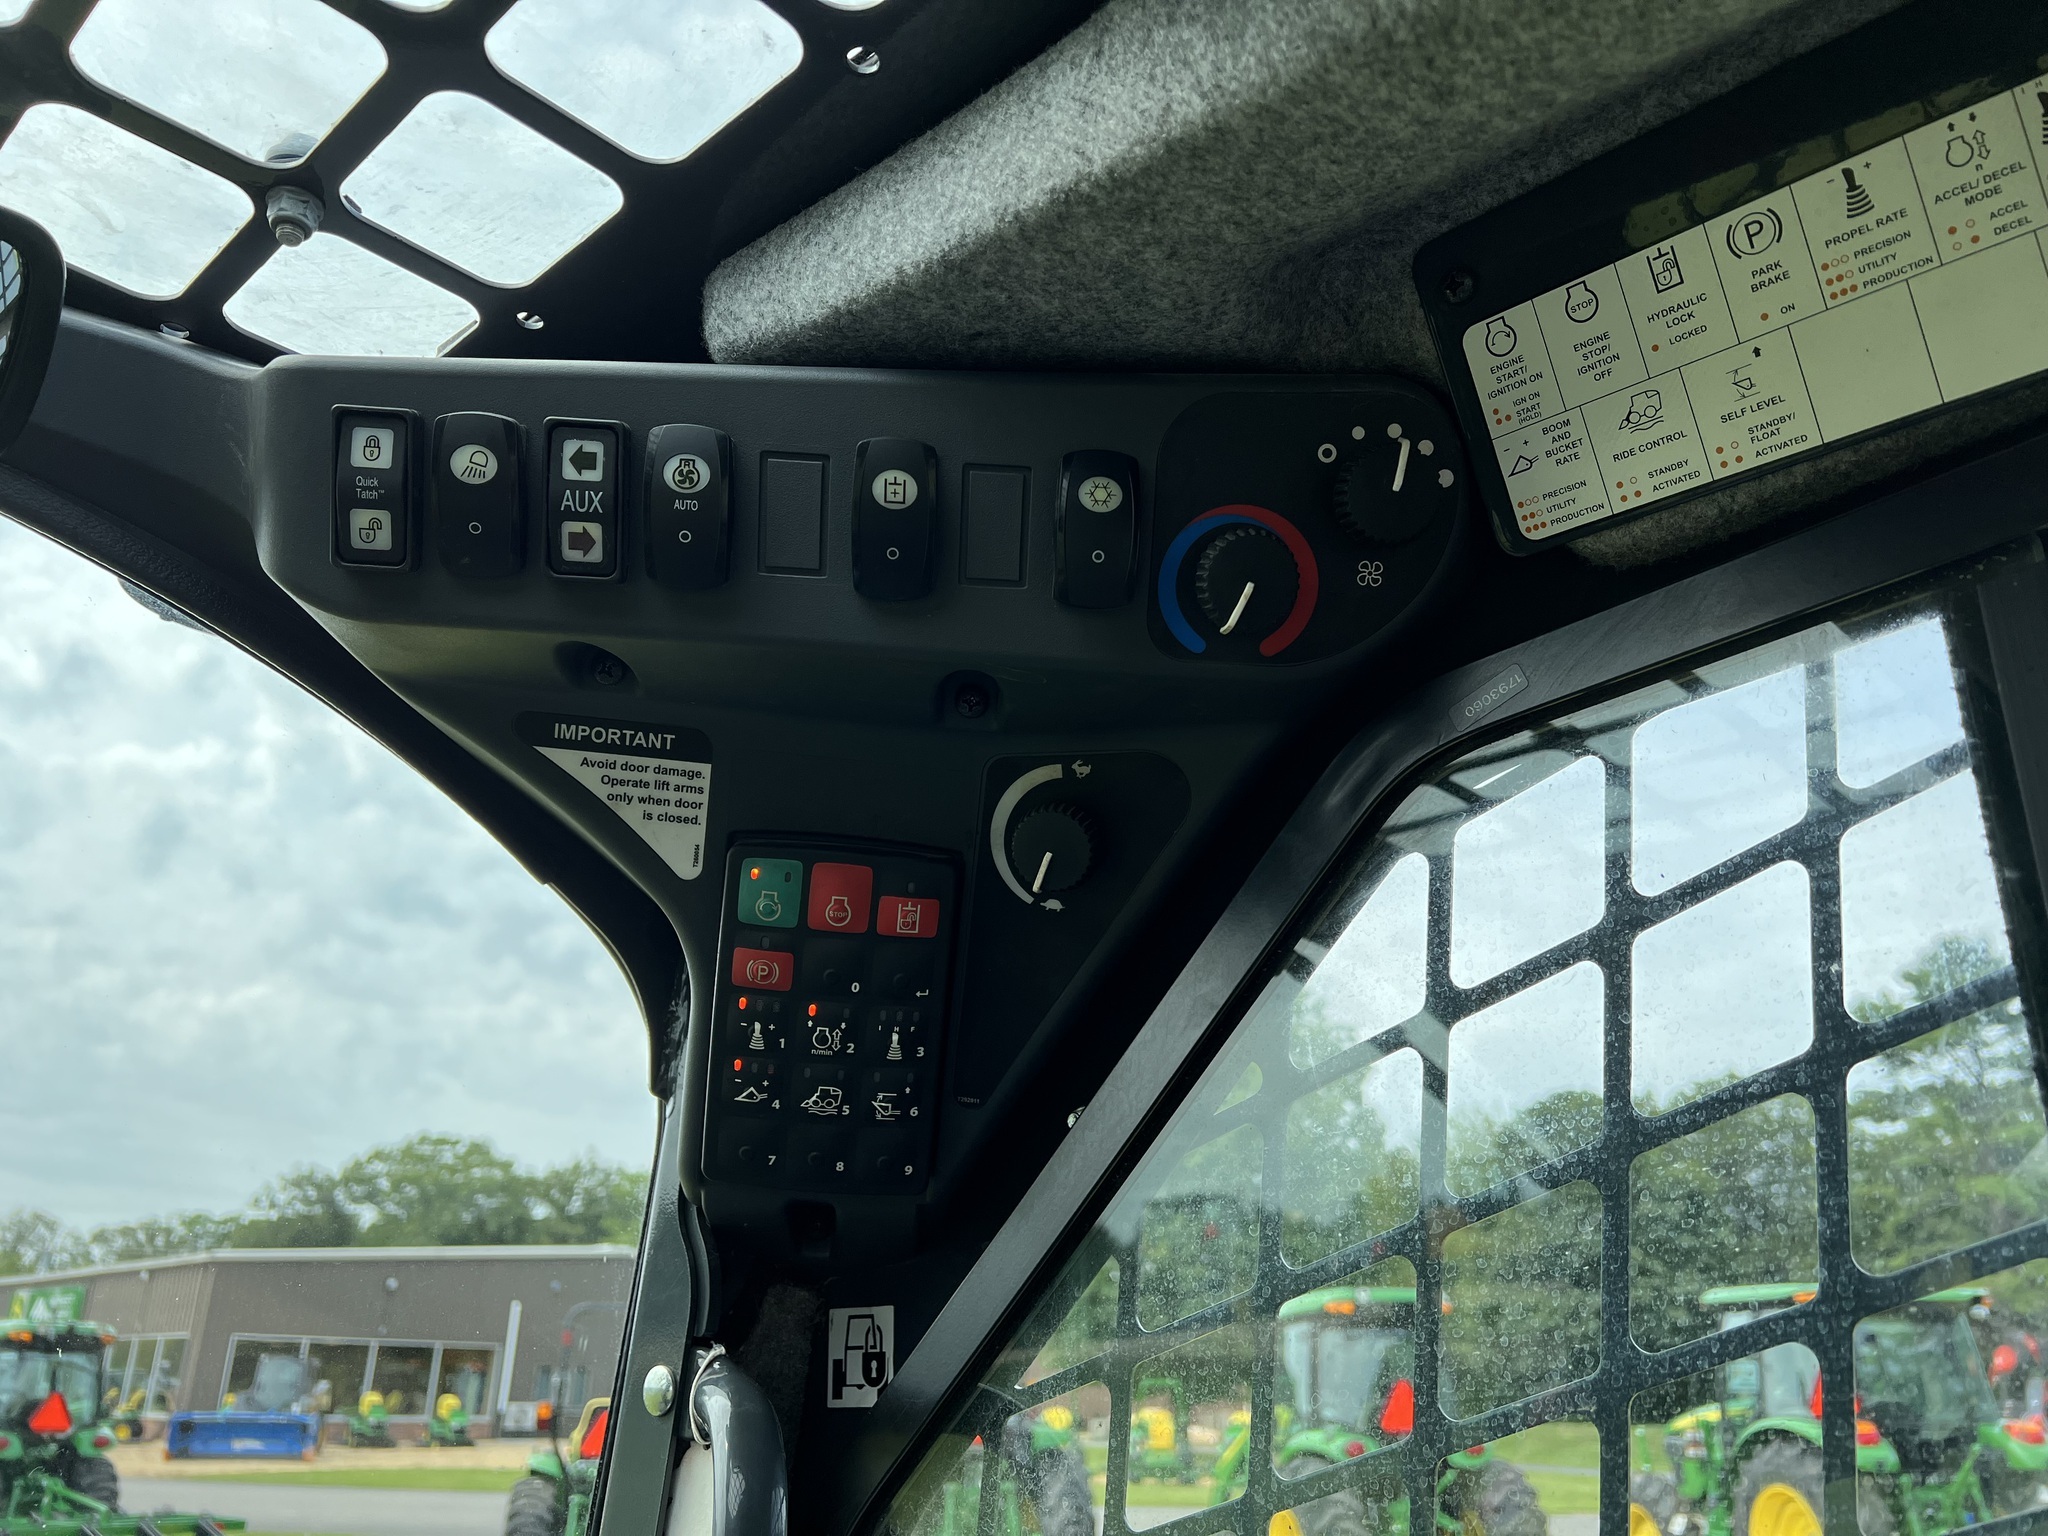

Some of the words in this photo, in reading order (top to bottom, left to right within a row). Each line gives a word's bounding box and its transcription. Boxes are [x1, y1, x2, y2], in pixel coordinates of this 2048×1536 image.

[1933, 178, 1980, 205] ACCEL/
[1982, 160, 2028, 185] DECEL
[1964, 184, 2003, 207] MODE
[1988, 200, 2029, 221] ACCEL
[1743, 219, 1765, 249] P
[1824, 223, 1874, 249] PROPEL
[1875, 208, 1909, 228] RATE
[1993, 215, 2033, 237] DECEL
[1853, 230, 1912, 260] PRECISION
[1751, 260, 1783, 280] PARK
[1858, 252, 1898, 275] UTILITY
[1862, 255, 1935, 290] PRODUCTION
[1750, 270, 1791, 293] BRAKE
[1570, 299, 1595, 314] STOP
[1646, 292, 1708, 324] HYDRAULIC
[1780, 303, 1796, 316] ON
[1665, 311, 1696, 329] LOCK
[1573, 331, 1611, 353] ENGINE
[1668, 324, 1708, 346] LOCKED
[1581, 343, 1612, 362] STOP/
[1490, 355, 1525, 375] ENGINE
[1577, 352, 1621, 376] IGNITION
[1495, 366, 1528, 385] START/
[1593, 368, 1613, 382] OFF
[1487, 377, 1528, 400] IGNITION
[1529, 371, 1544, 385] ON
[1512, 395, 1526, 408] IGN
[1527, 391, 1541, 403] ON
[1515, 402, 1541, 419] START
[1518, 411, 1543, 426] (HOLD)
[1720, 406, 1748, 424] SELF
[1749, 395, 1786, 415] LEVEL
[1541, 418, 1572, 436] BOOM
[1747, 412, 1797, 436] STANDBY/
[1550, 430, 1572, 445] AND
[1750, 427, 1782, 444] FLOAT
[1544, 438, 1584, 459] BUCKET
[1612, 446, 1637, 463] RIDE
[1638, 430, 1688, 455] CONTROL
[1754, 434, 1809, 459] ACTIVATED
[1555, 452, 1581, 467] RATE
[1647, 459, 1690, 480] STANDBY
[355, 475, 379, 488] Quick
[1541, 479, 1587, 501] PRECISION
[1652, 470, 1701, 492] ACTIVATED
[560, 490, 603, 514] AUX
[673, 499, 699, 511] AUTO
[1546, 497, 1577, 515] UTILITY
[1549, 502, 1605, 527] PRODUCTION
[1465, 674, 1522, 717] 1793060
[554, 722, 676, 750] IMPORTANT
[580, 756, 617, 770] Avoid
[620, 760, 650, 773] door
[653, 764, 706, 781] damage.
[600, 774, 650, 789] Operate
[654, 779, 670, 792] lift
[673, 783, 705, 795] arms
[606, 792, 634, 805] only
[637, 794, 671, 807] when
[674, 796, 704, 810] door
[642, 810, 653, 821] is
[657, 812, 702, 826] closed.
[829, 910, 847, 919] STOP
[757, 965, 769, 979] P
[851, 982, 860, 993] 0
[779, 1038, 785, 1049] 1
[811, 1048, 833, 1056] n/min
[846, 1043, 855, 1053] 2
[916, 1047, 925, 1057] 3
[772, 1099, 780, 1110] 4
[842, 1105, 850, 1115] 5
[910, 1106, 919, 1117] 6
[768, 1155, 777, 1166] 7
[836, 1161, 844, 1172] 8
[904, 1165, 913, 1176] 9
